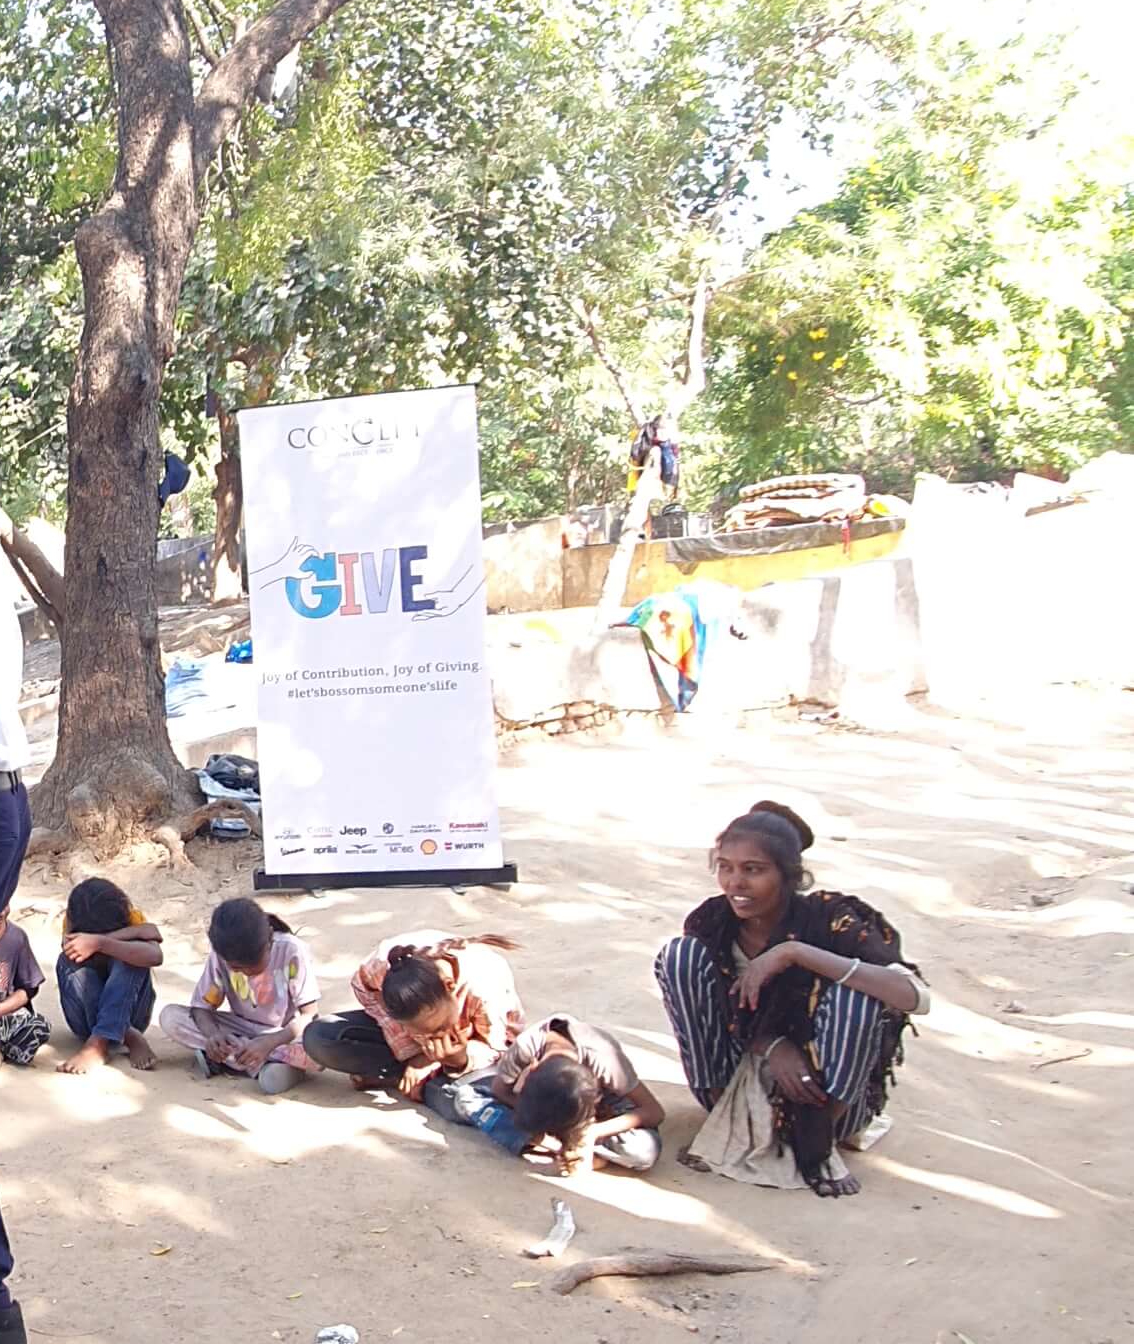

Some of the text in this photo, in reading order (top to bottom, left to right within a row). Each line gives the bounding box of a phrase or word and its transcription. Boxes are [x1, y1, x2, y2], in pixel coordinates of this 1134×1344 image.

[285, 545, 436, 619] GIVE
[285, 670, 299, 681] of
[393, 664, 413, 677] Joy
[417, 662, 432, 674] of
[339, 825, 367, 836] Jeep
